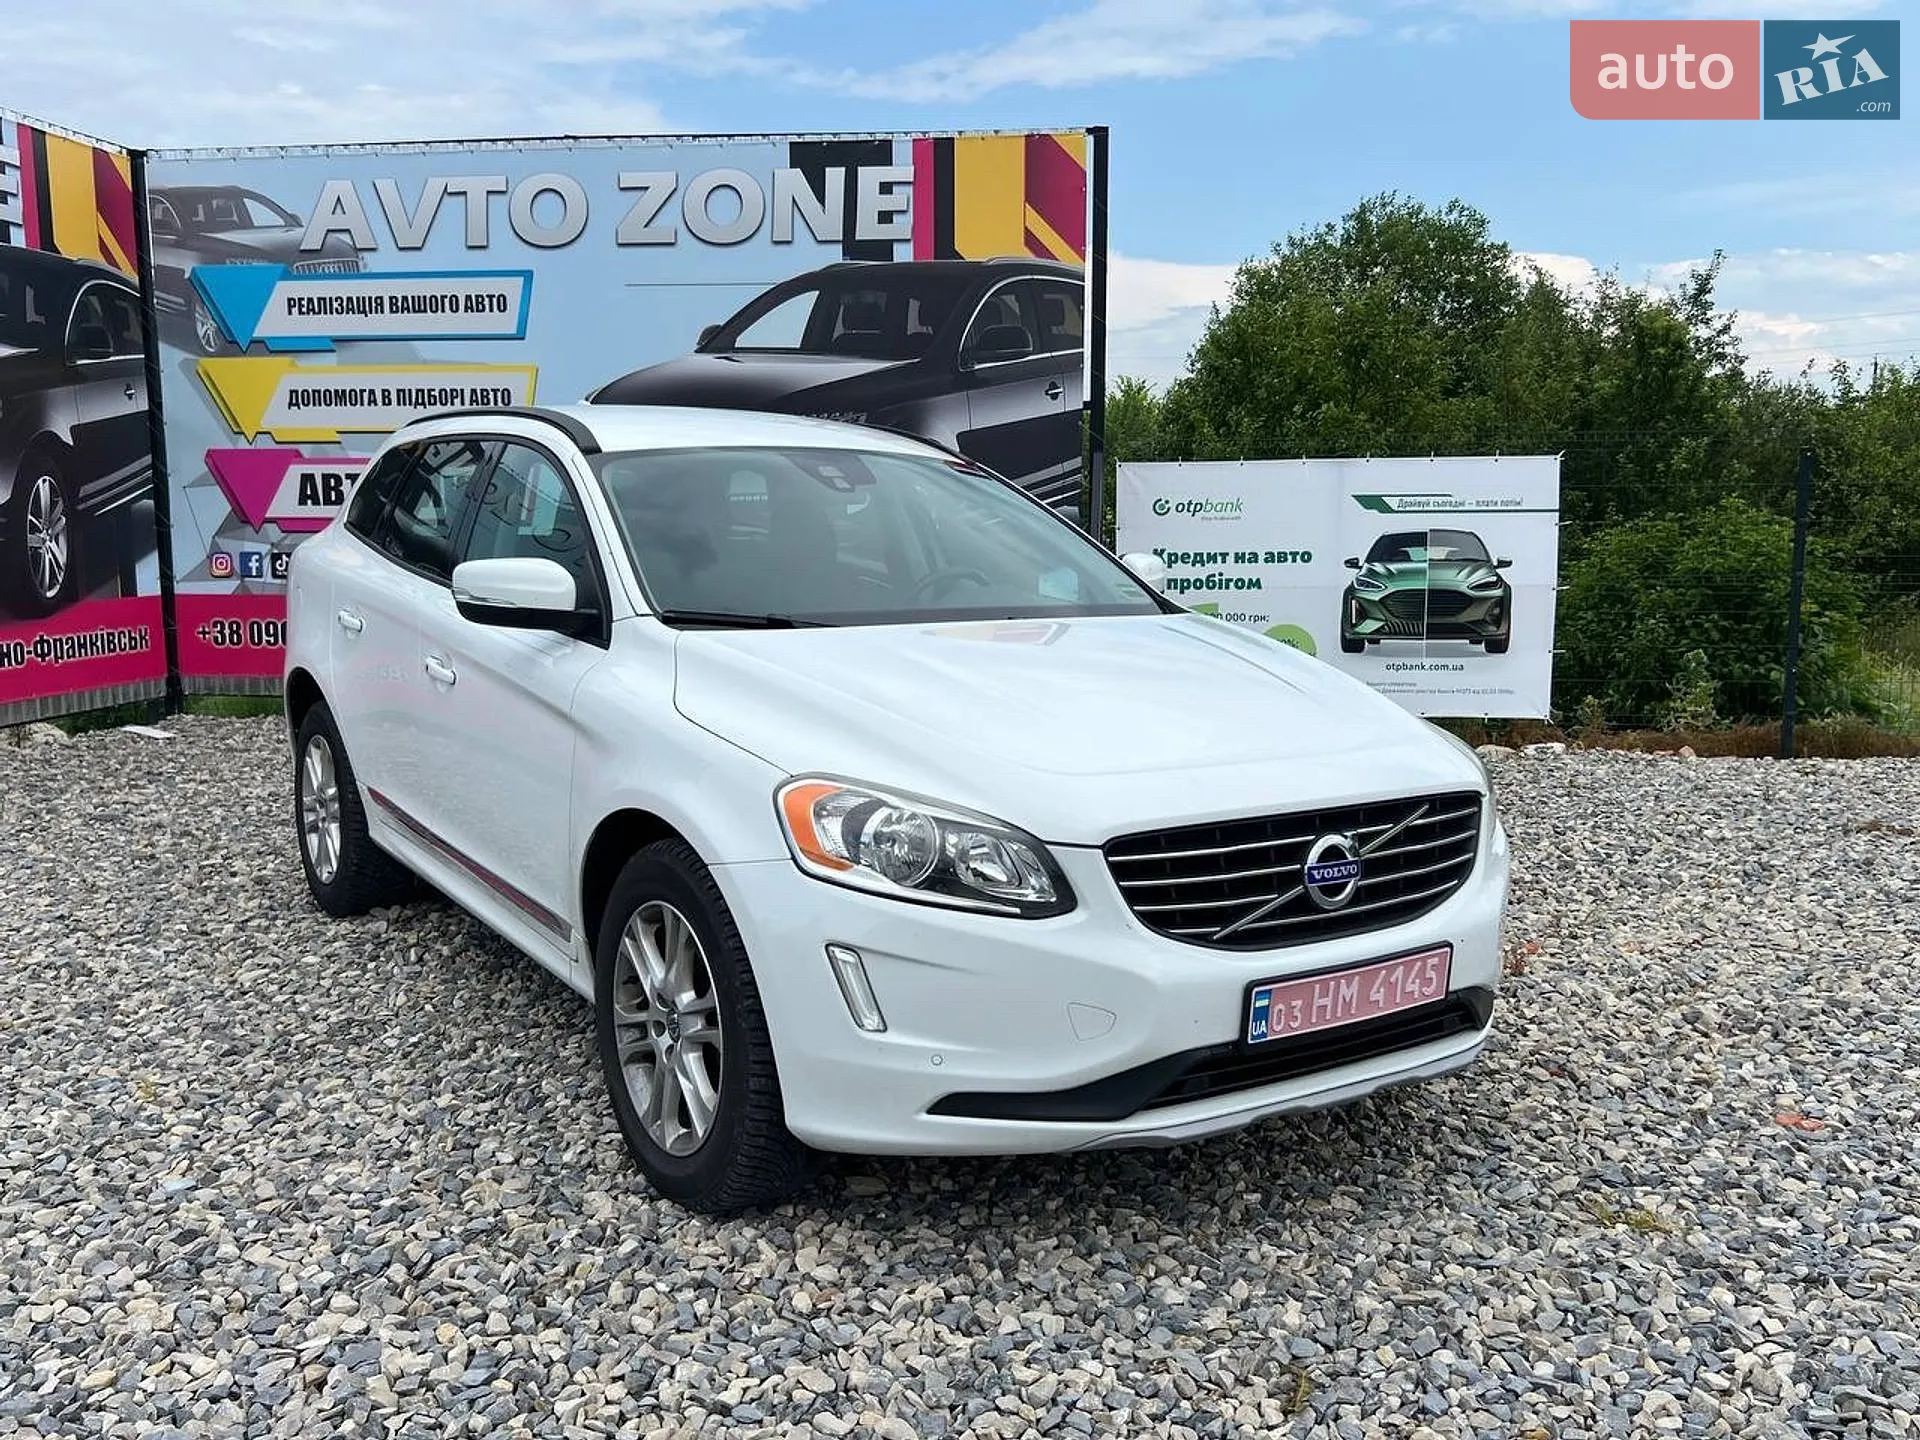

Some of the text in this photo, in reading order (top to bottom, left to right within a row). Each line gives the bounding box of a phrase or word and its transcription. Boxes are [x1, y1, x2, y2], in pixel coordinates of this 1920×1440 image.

[300, 166, 915, 252] AVTO ZONE
[286, 293, 508, 318] РЕАЛІЗАЦІЯ ВАШОГО АВТО
[287, 387, 512, 410] ДОПОМОГА В ПІДБОРІ АВТО
[1175, 498, 1244, 517] otpbank
[1233, 551, 1260, 564] на
[1264, 550, 1313, 564] авто
[1166, 572, 1263, 595] пробігом
[196, 619, 243, 648] +38
[1385, 661, 1465, 672] otpbank.com.ua
[1310, 863, 1358, 880] VOLVO
[1271, 957, 1440, 1032] 03 HM 4145
[1251, 1020, 1268, 1036] UA
